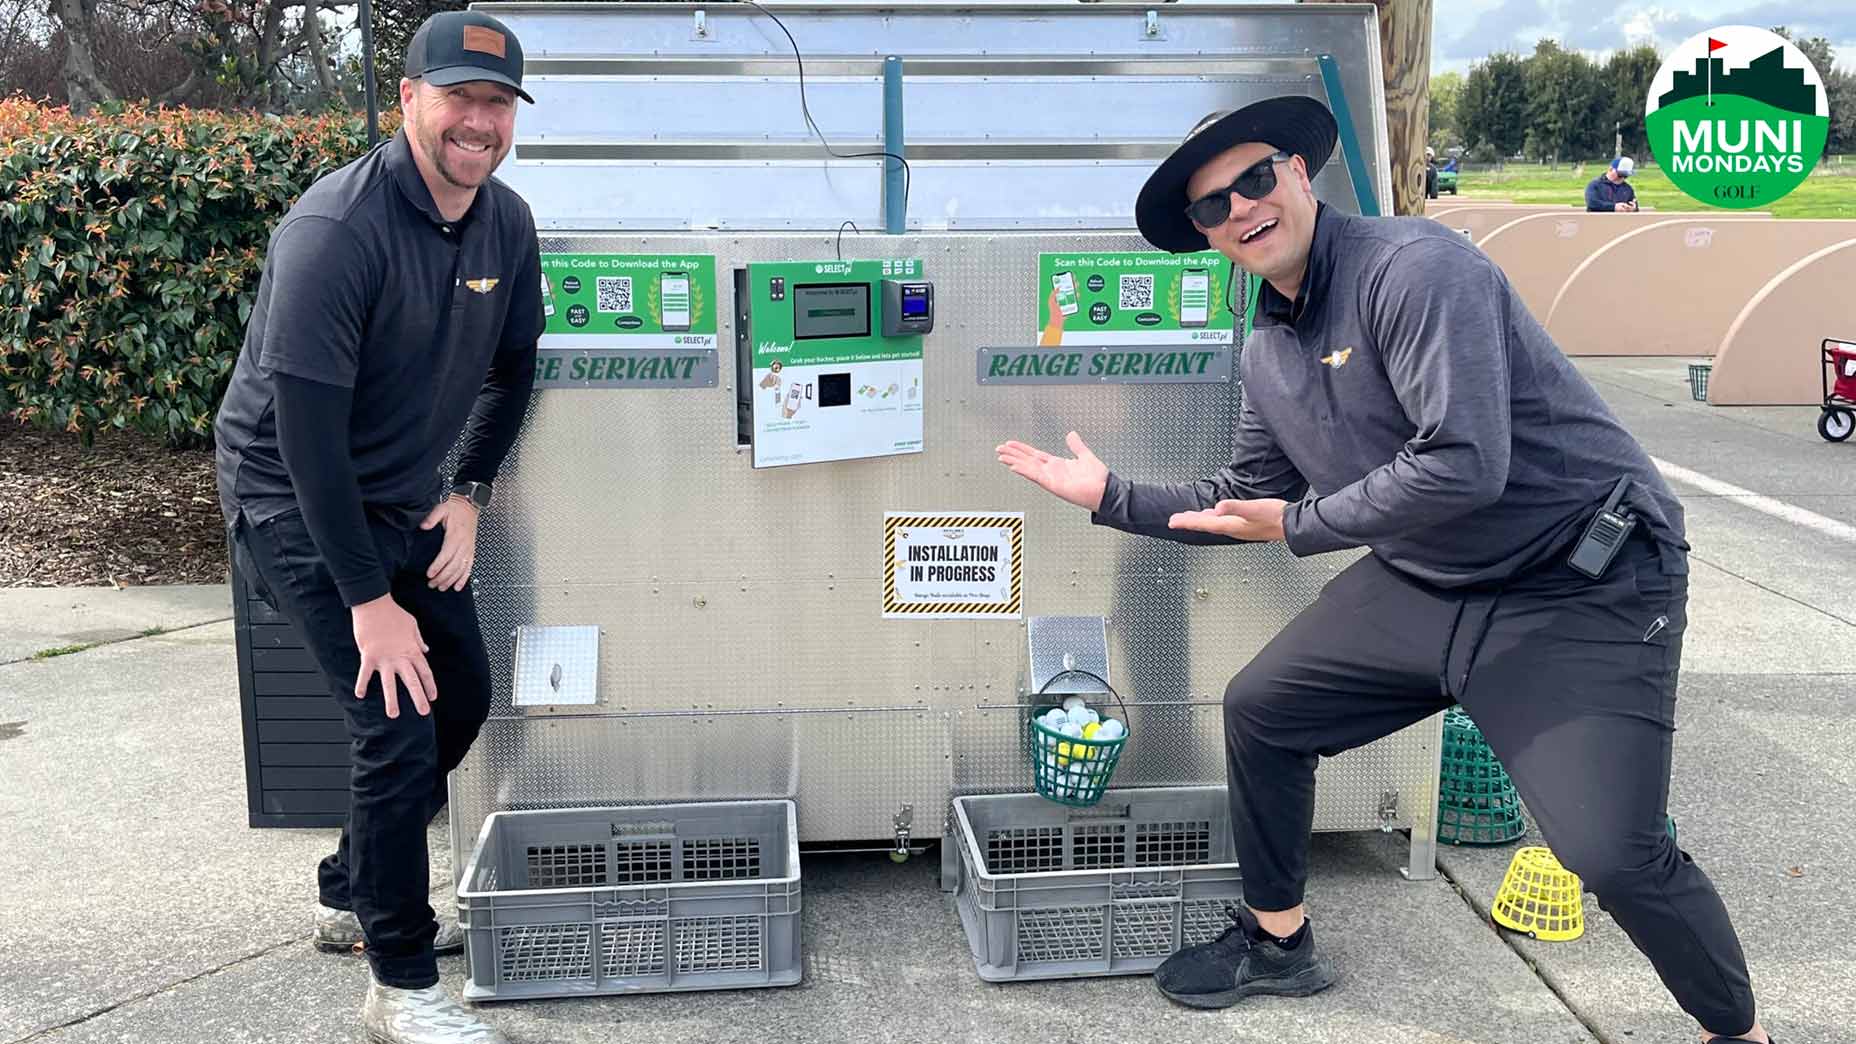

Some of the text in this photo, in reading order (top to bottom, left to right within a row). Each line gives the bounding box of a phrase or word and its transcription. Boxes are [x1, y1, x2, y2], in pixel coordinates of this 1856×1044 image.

[552, 259, 568, 268] this
[571, 259, 596, 268] Code
[599, 260, 609, 268] to
[612, 259, 659, 268] Download
[662, 260, 677, 268] the
[680, 260, 699, 270] App
[1055, 256, 1220, 267] Scan this Code to Download the App
[569, 356, 700, 380] SERVANT
[988, 351, 1215, 377] RANGE SERVANT
[908, 545, 998, 562] INSTALLATION
[910, 566, 996, 582] IN PROGRESS
